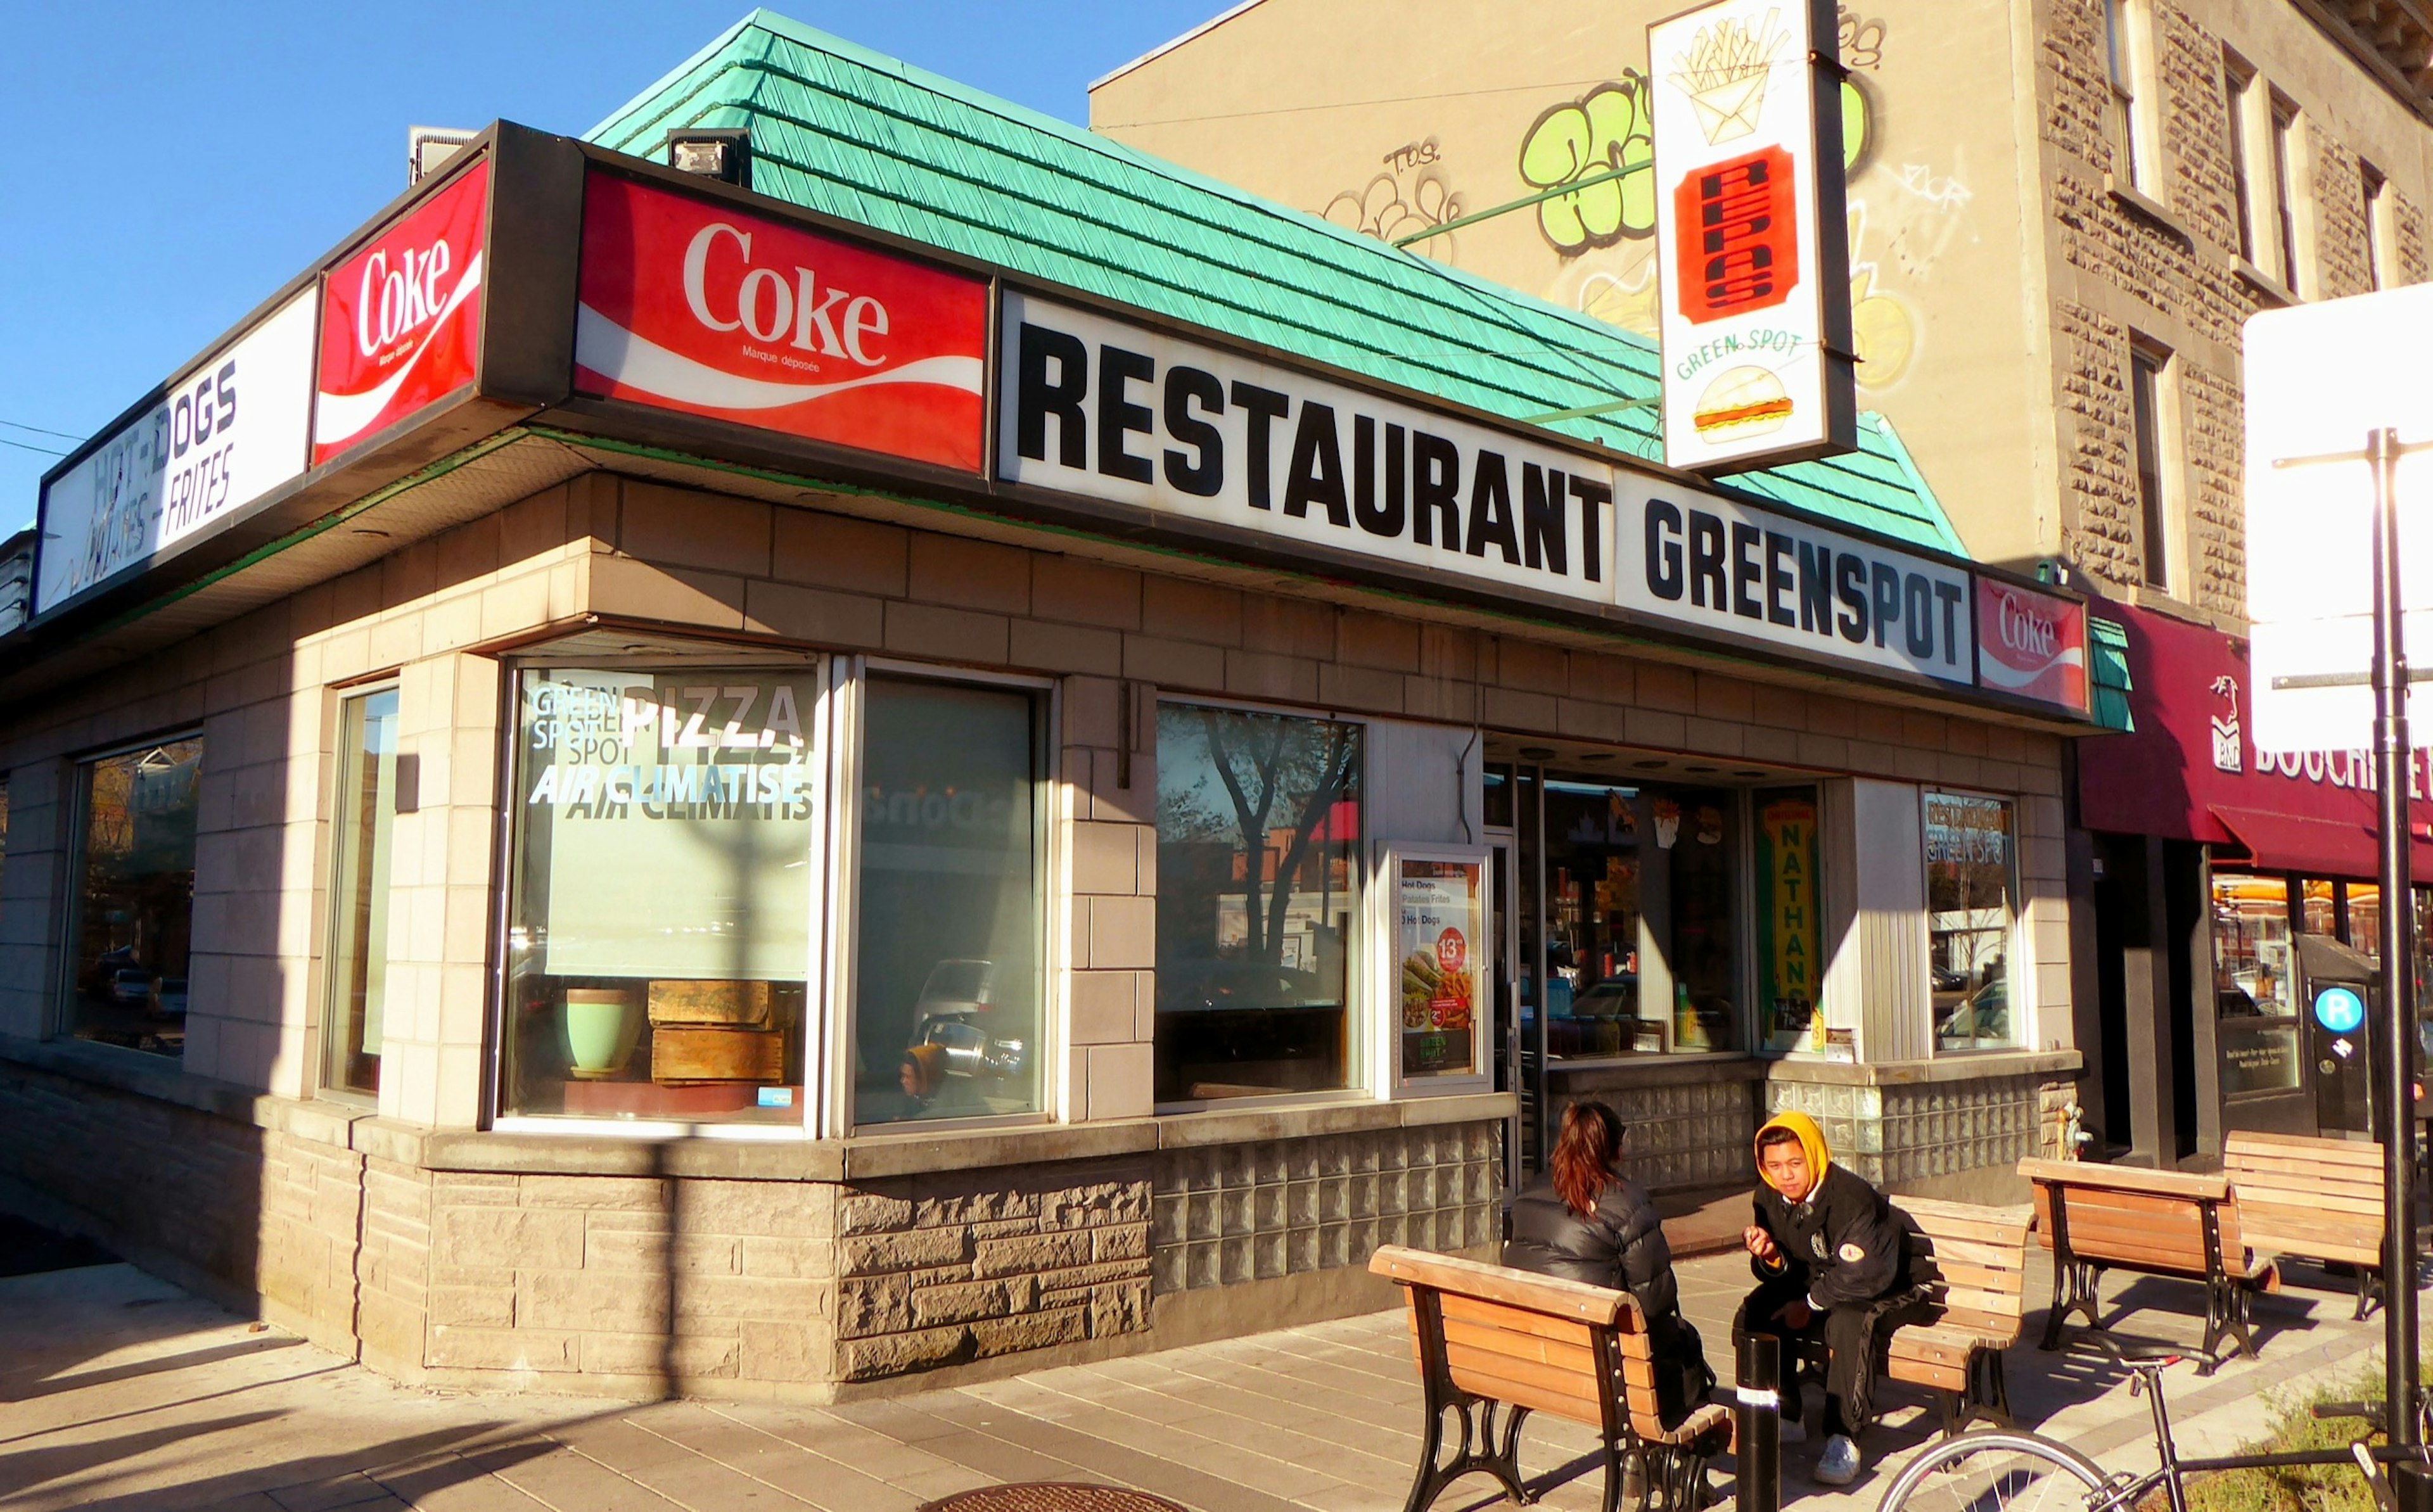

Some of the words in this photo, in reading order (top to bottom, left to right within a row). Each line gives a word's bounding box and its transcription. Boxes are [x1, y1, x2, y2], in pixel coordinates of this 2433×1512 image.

[1701, 158, 1773, 308] REPAS
[359, 239, 450, 357] Coke
[683, 222, 889, 367] Coke
[743, 345, 778, 363] Marque
[781, 355, 821, 372] déposée
[1676, 334, 1737, 380] GREEN
[1747, 329, 1803, 357] SPOT
[1017, 321, 1613, 583] RESTAURANT
[1644, 498, 1962, 666] GREENSPOT
[1999, 592, 2055, 659] Coke
[533, 686, 617, 716] GREEN
[623, 685, 805, 748] PIZZA
[532, 720, 601, 750] SPOT
[529, 765, 601, 804] AIR
[605, 754, 804, 804] CLIMATISÉ
[1402, 894, 1430, 904] Patates
[1431, 894, 1450, 904] Frites
[1417, 881, 1436, 891] Dogs
[1422, 915, 1440, 926] Dogs
